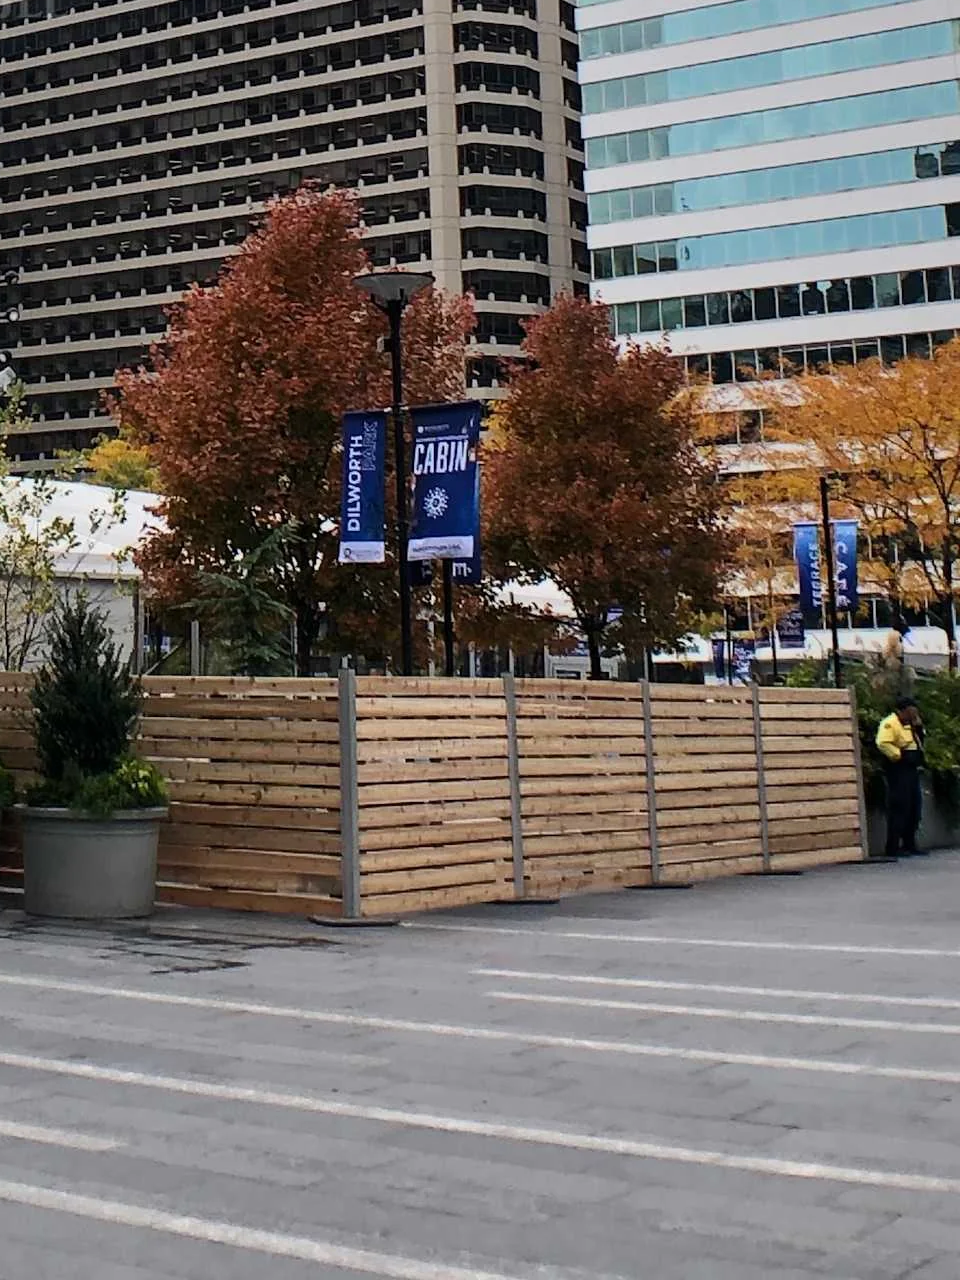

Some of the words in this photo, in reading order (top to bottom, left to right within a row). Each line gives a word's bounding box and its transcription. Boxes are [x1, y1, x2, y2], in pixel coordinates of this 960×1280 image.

[347, 435, 363, 532] DILWORTH
[413, 439, 469, 475] CABIN
[807, 542, 822, 608] TERRACE
